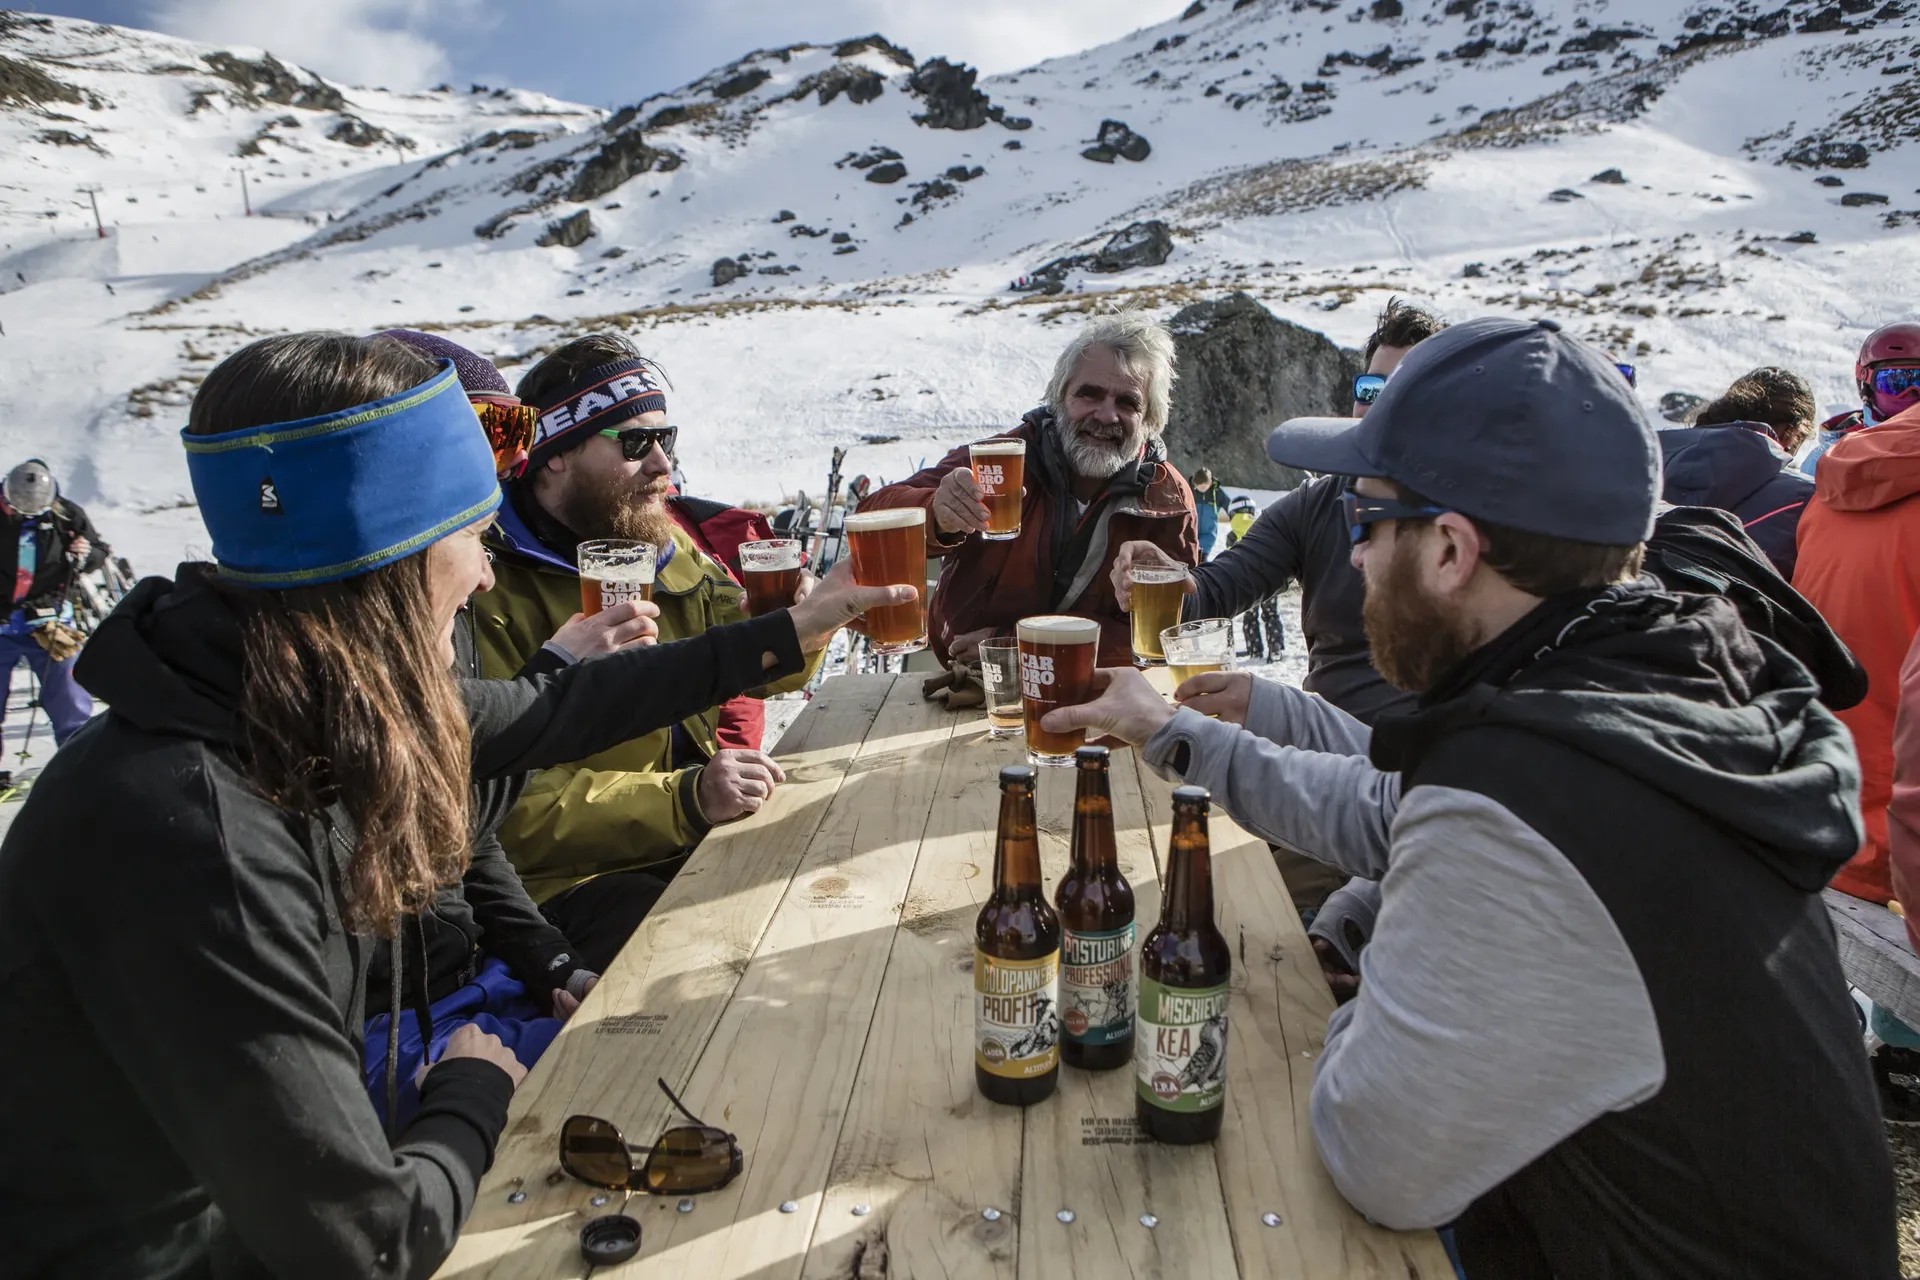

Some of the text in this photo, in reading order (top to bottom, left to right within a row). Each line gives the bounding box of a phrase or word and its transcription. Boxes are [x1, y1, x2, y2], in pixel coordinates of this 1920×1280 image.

[976, 464, 1003, 475] CAR
[978, 474, 1004, 485] DRO
[1021, 652, 1054, 672] CAR
[1022, 666, 1055, 686] DRO
[1022, 680, 1042, 699] NA
[1064, 930, 1133, 965] POSTURING
[983, 992, 1038, 1025] PROFIT
[1156, 1026, 1191, 1058] KEA
